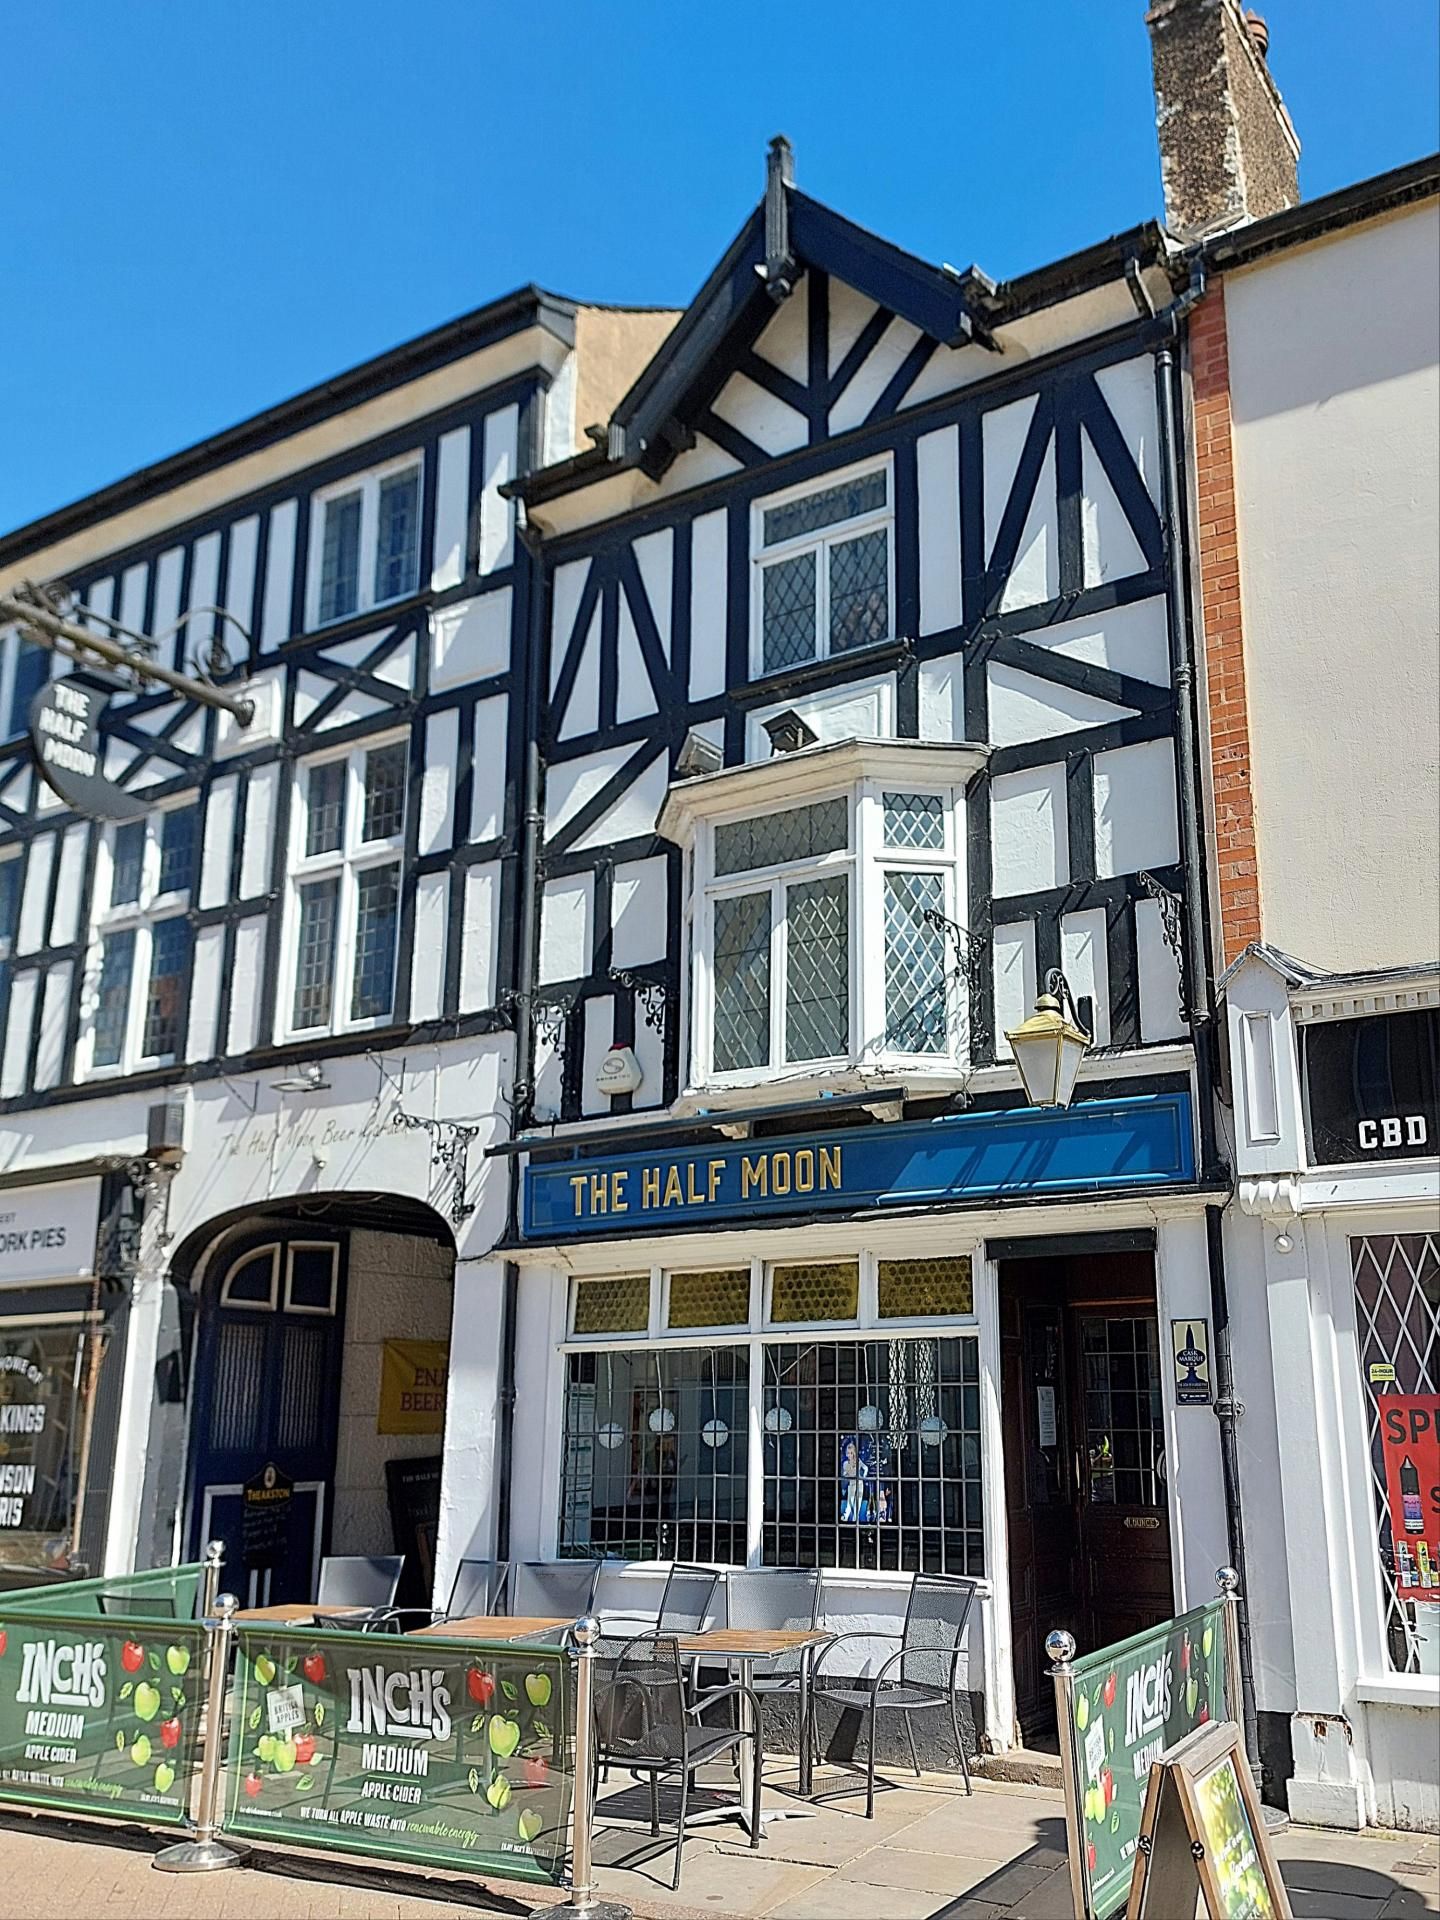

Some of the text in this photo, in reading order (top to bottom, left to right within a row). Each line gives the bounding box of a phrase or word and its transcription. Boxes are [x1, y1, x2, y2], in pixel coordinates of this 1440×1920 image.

[53, 683, 90, 718] THE
[38, 707, 88, 743] HALF
[43, 737, 96, 777] MOON
[320, 1119, 355, 1145] Beer
[1359, 1116, 1427, 1149] CBD
[570, 1146, 841, 1216] THE HALF MOON
[31, 1227, 66, 1248] PIES
[0, 1404, 46, 1433] KINGS
[25, 1711, 85, 1739] MEDIUM
[24, 1744, 77, 1764] APPLE CIDER
[361, 1744, 428, 1777] MEDIUM
[361, 1781, 422, 1805] APPLE CIDER
[301, 1806, 311, 1818] WE
[312, 1808, 327, 1821] TURN
[328, 1810, 339, 1821] ALL
[339, 1810, 363, 1826] APPLE
[364, 1813, 390, 1830] WASTE
[390, 1817, 407, 1832] INTO
